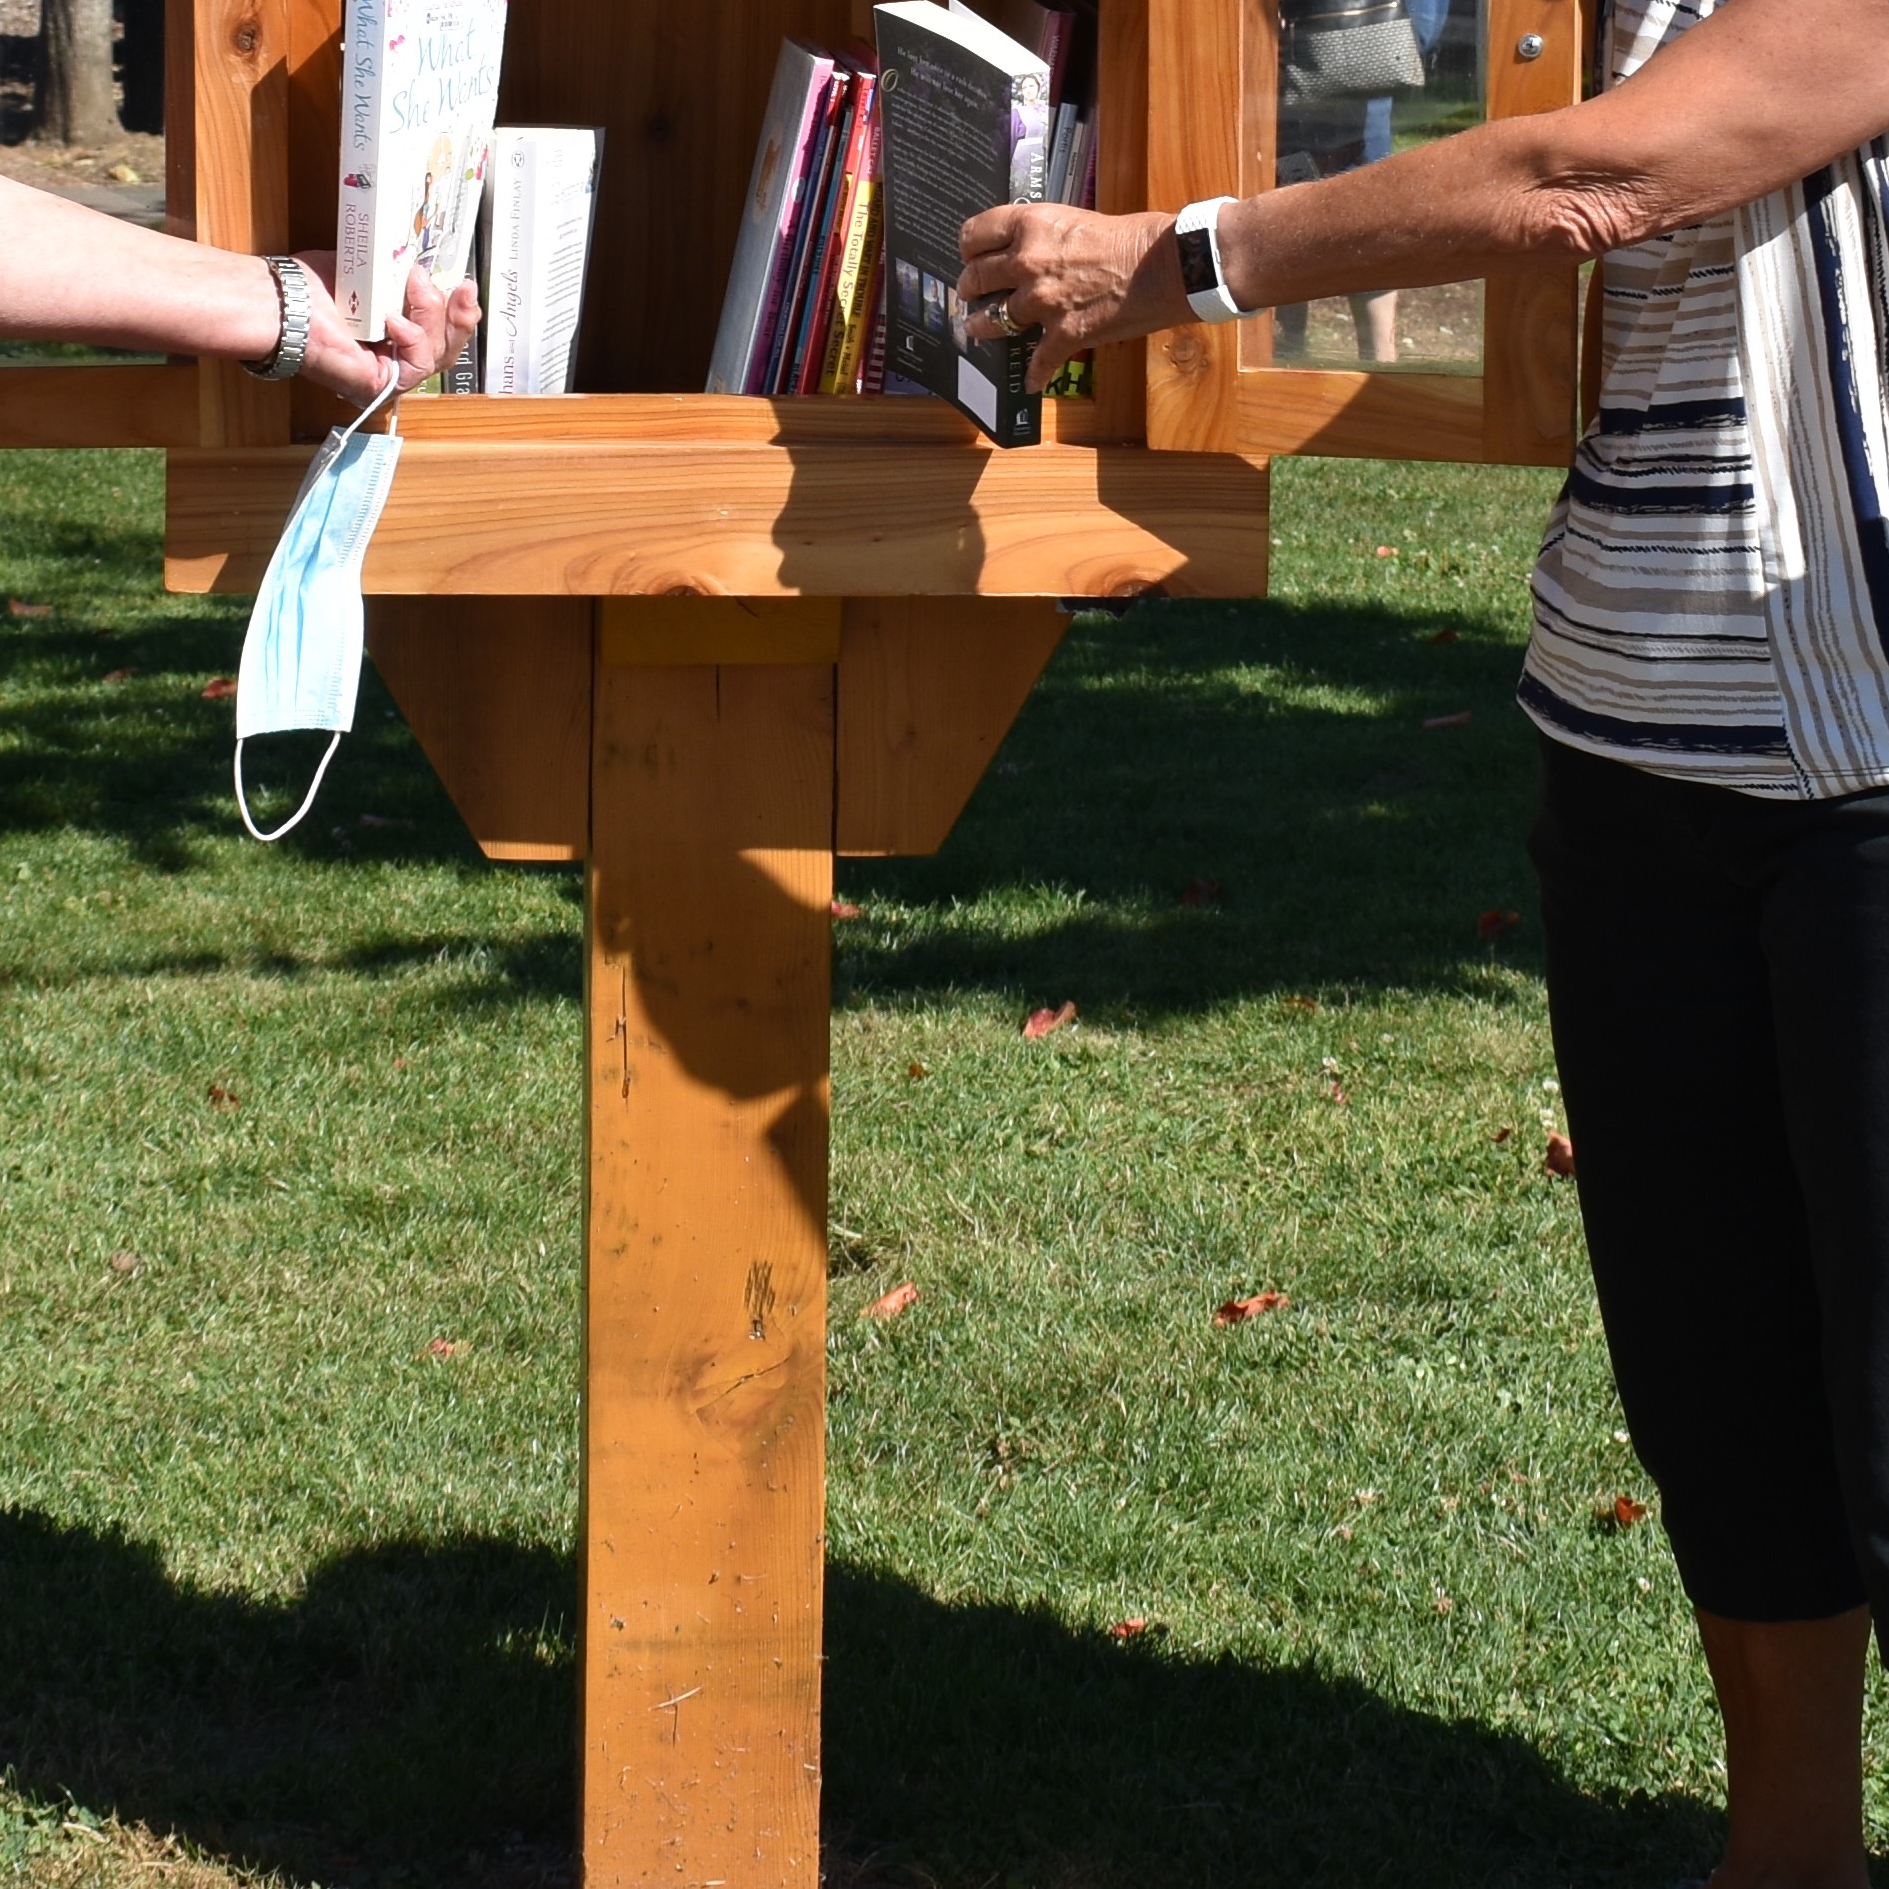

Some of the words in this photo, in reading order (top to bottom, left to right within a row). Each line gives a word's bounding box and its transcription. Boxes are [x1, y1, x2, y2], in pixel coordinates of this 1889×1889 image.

[418, 17, 476, 76] What
[354, 53, 376, 88] She
[389, 78, 430, 134] She
[438, 54, 494, 116] Wants
[353, 94, 372, 151] Wants
[868, 126, 880, 156] BALLET
[1030, 152, 1044, 199] ARMS
[511, 178, 523, 220] FINLAY
[854, 202, 868, 228] The
[343, 203, 357, 275] ROBERTS
[356, 212, 369, 268] SHEILA
[509, 231, 518, 260] LINDA
[842, 229, 863, 277] Totally
[499, 269, 523, 337] Angels
[833, 280, 853, 326] Secret
[824, 330, 843, 376] Secret
[1010, 347, 1020, 393] REID
